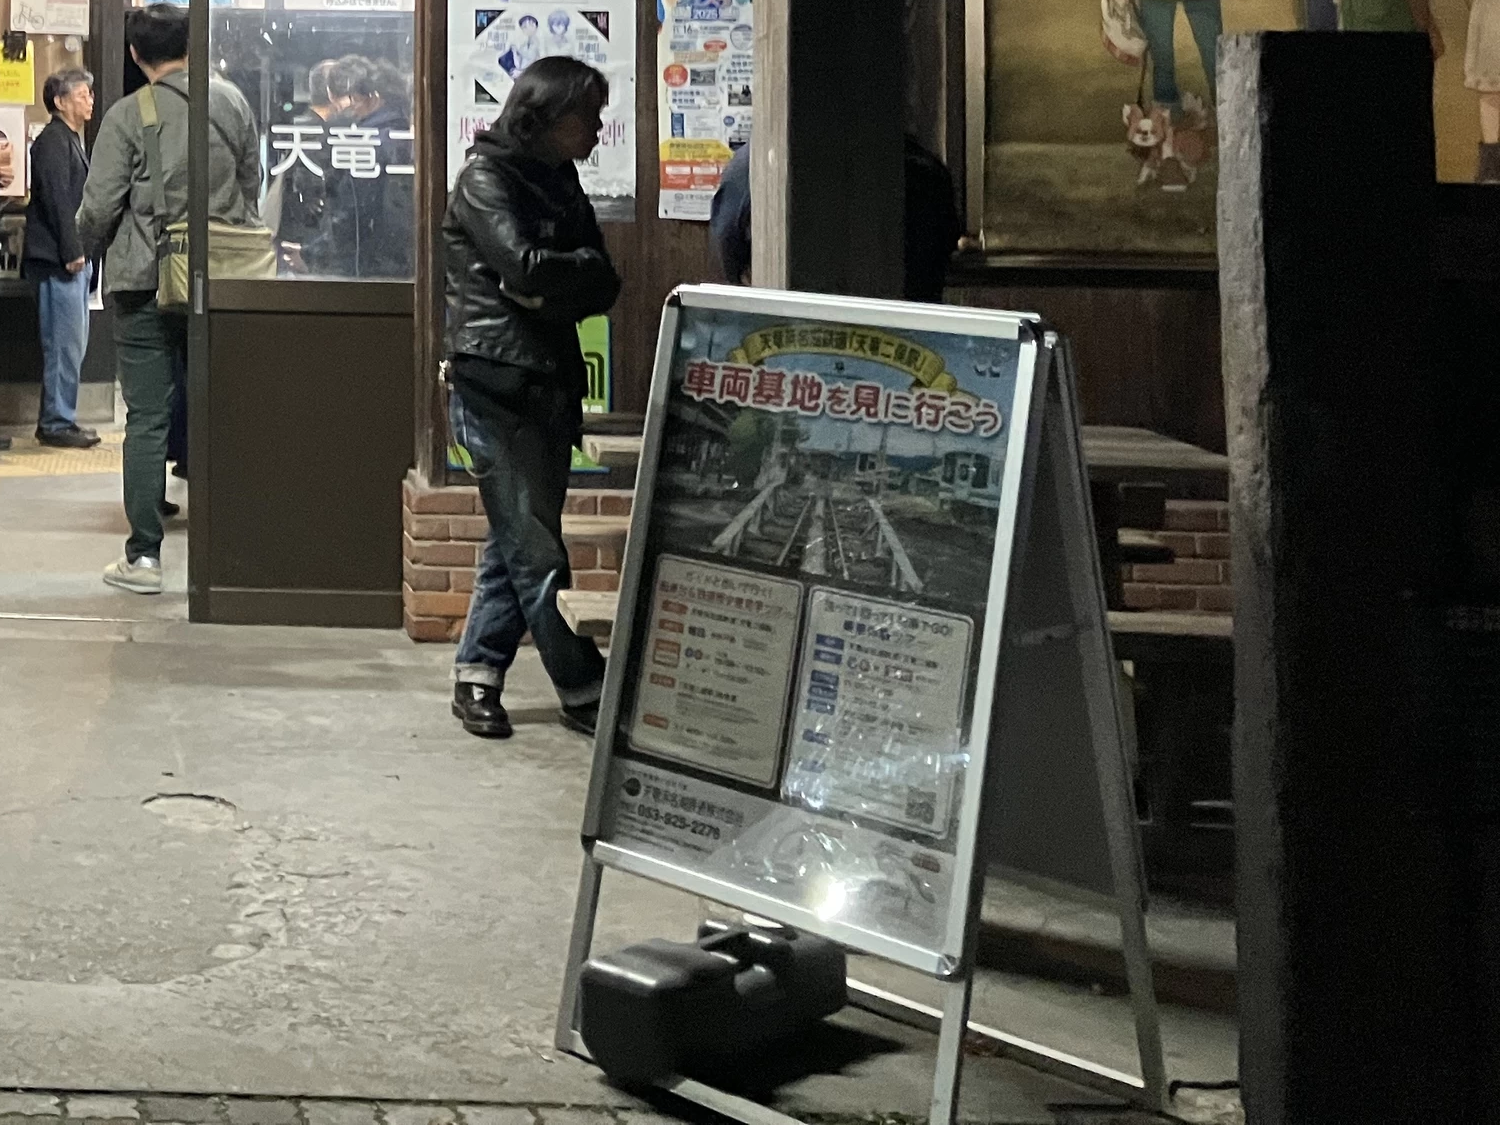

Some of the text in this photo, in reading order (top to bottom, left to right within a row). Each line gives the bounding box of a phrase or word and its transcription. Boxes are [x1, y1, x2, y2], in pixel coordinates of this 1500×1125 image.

[270, 124, 415, 179] 天竜二
[685, 363, 1000, 434] 車両基地を見に行こう
